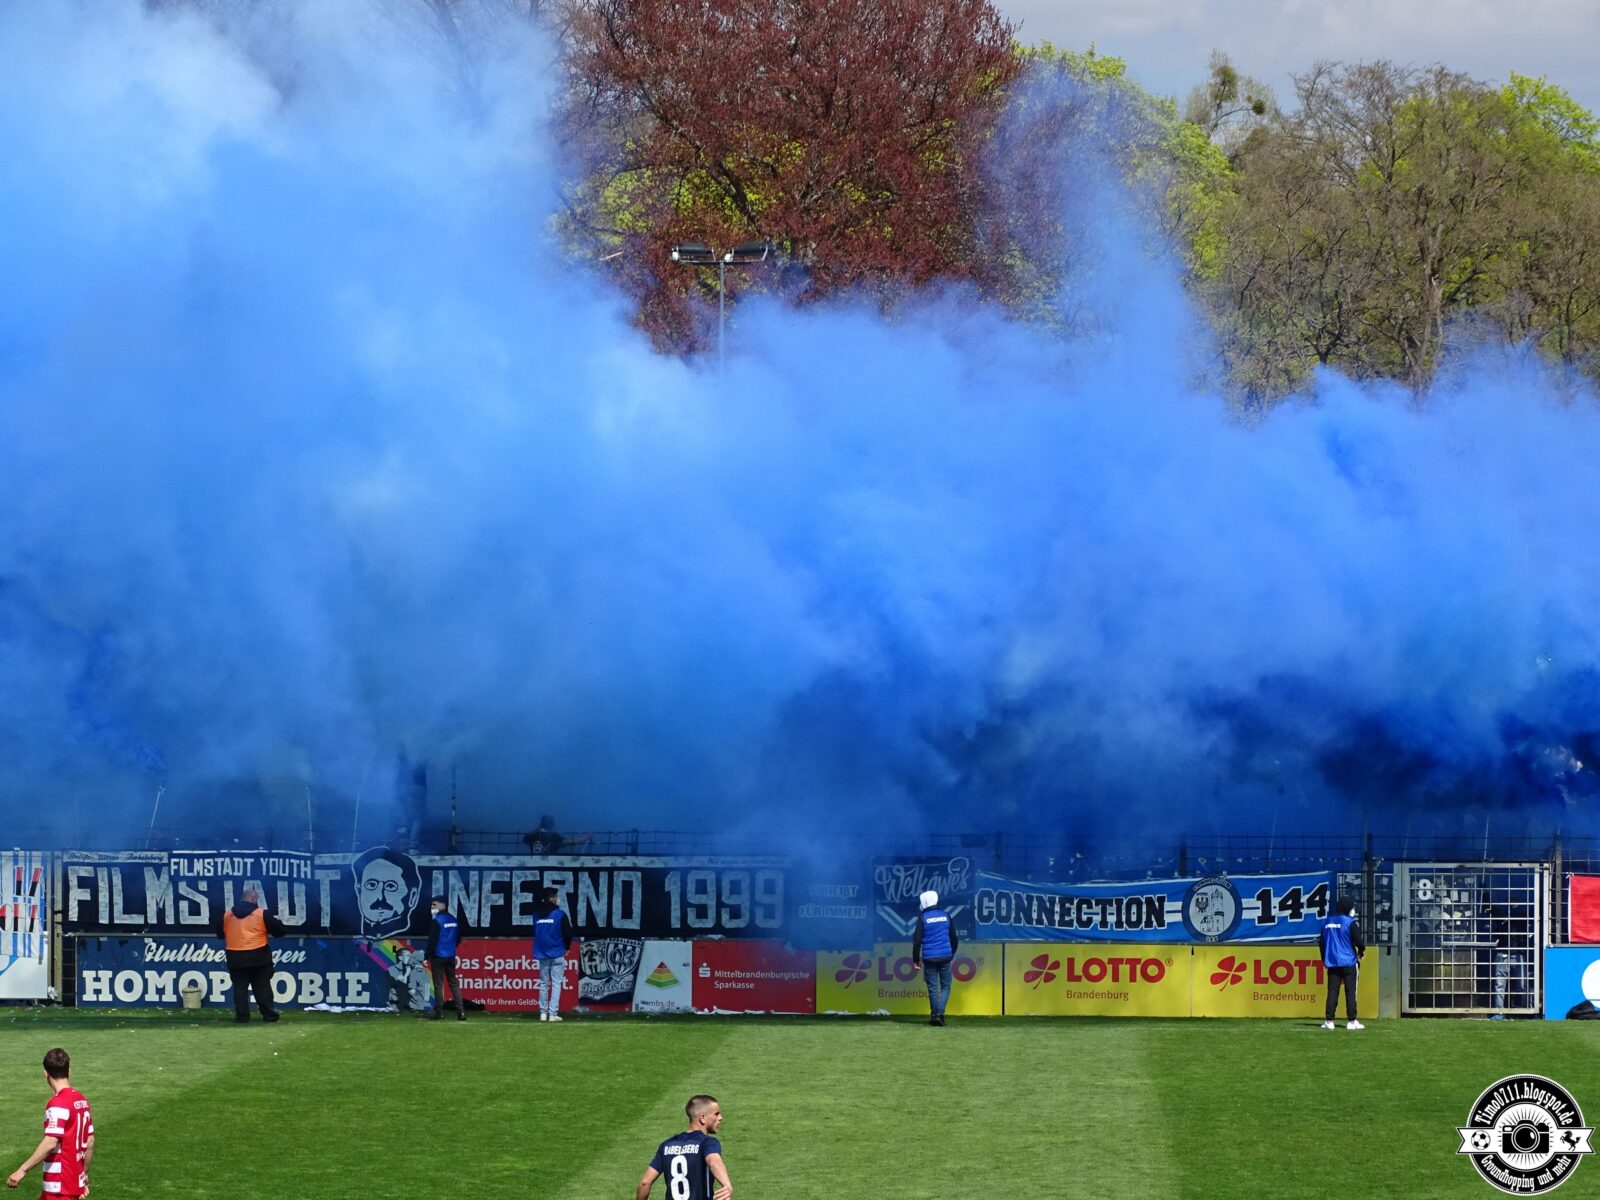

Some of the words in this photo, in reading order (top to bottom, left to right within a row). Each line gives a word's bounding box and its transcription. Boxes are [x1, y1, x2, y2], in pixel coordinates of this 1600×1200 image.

[170, 857, 254, 877] FILMSTADT
[260, 857, 312, 879] YOUTH
[664, 870, 784, 928] 1999
[975, 888, 1168, 931] CONNECTION
[1255, 882, 1330, 926] 144
[484, 955, 579, 973] Sparkaen
[714, 970, 810, 980] Mittelbrandenburgische
[878, 957, 977, 982] LOO
[1066, 957, 1166, 983] LOTTO
[1253, 959, 1326, 985] LOTT
[82, 970, 370, 1004] HOMOPOBIE
[455, 974, 574, 990] inanzkonzt.
[714, 981, 755, 990] Sparkasse
[878, 989, 941, 999] Brandenbu
[1066, 990, 1129, 1001] Brandenburg
[1253, 992, 1317, 1002] Brandenburg
[671, 1155, 690, 1200] 8
